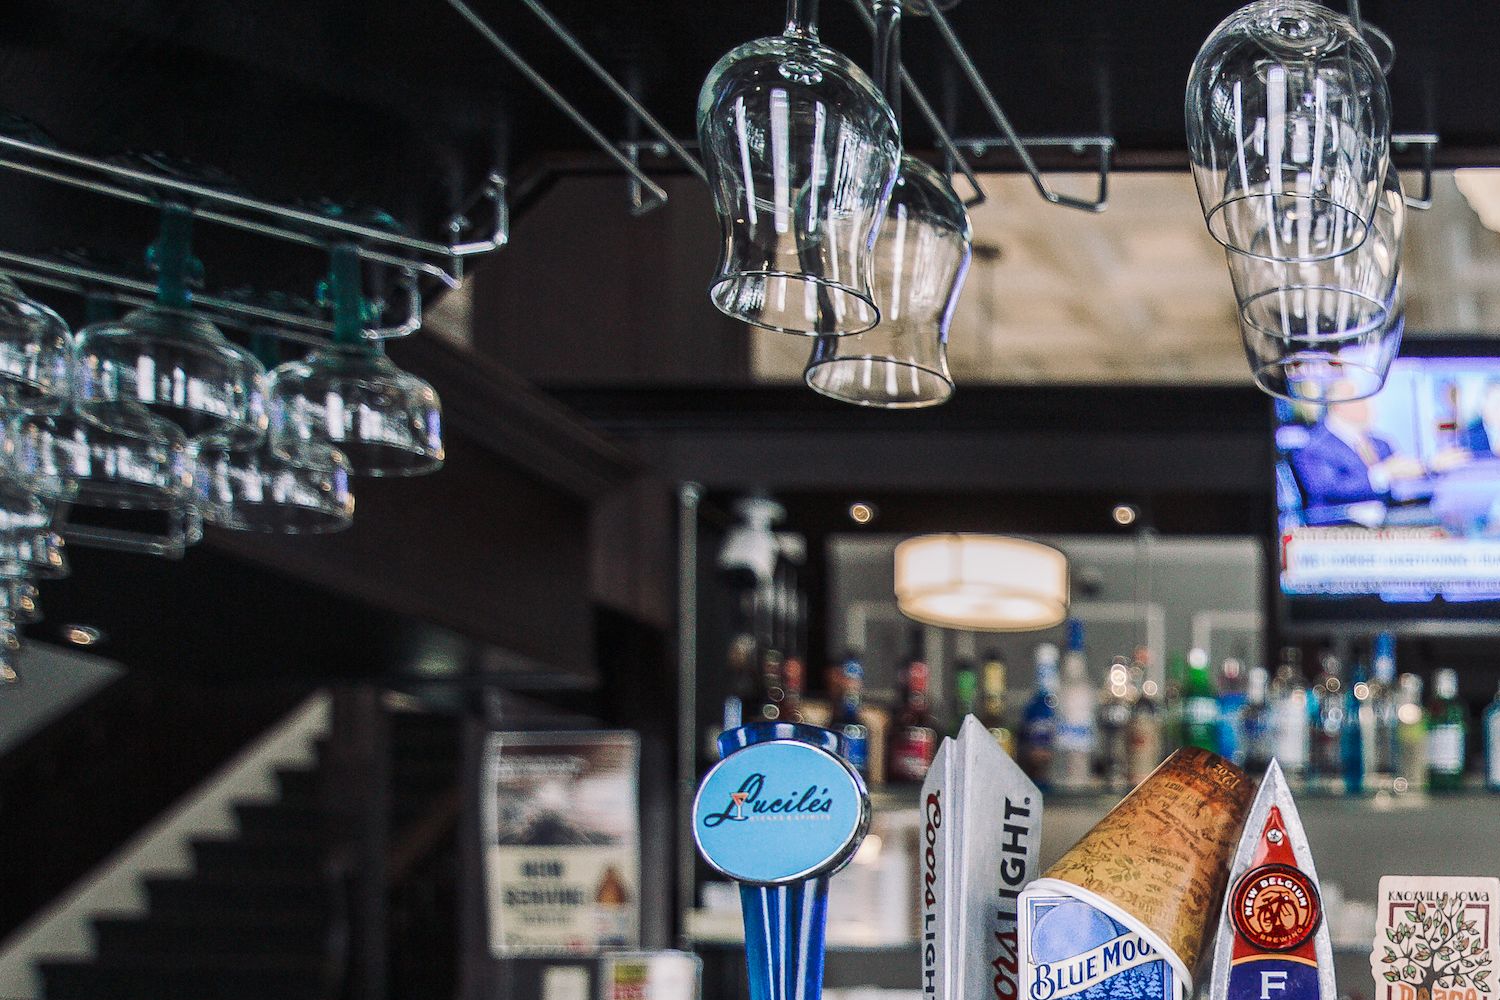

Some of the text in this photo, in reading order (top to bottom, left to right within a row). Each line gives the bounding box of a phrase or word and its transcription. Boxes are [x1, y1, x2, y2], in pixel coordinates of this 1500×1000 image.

[703, 773, 833, 828] Lucile's
[924, 789, 942, 912] Coors
[1244, 877, 1308, 916] NEW BELGIUM
[1259, 926, 1304, 943] BREWING
[1030, 934, 1159, 1000] BLUE MOO
